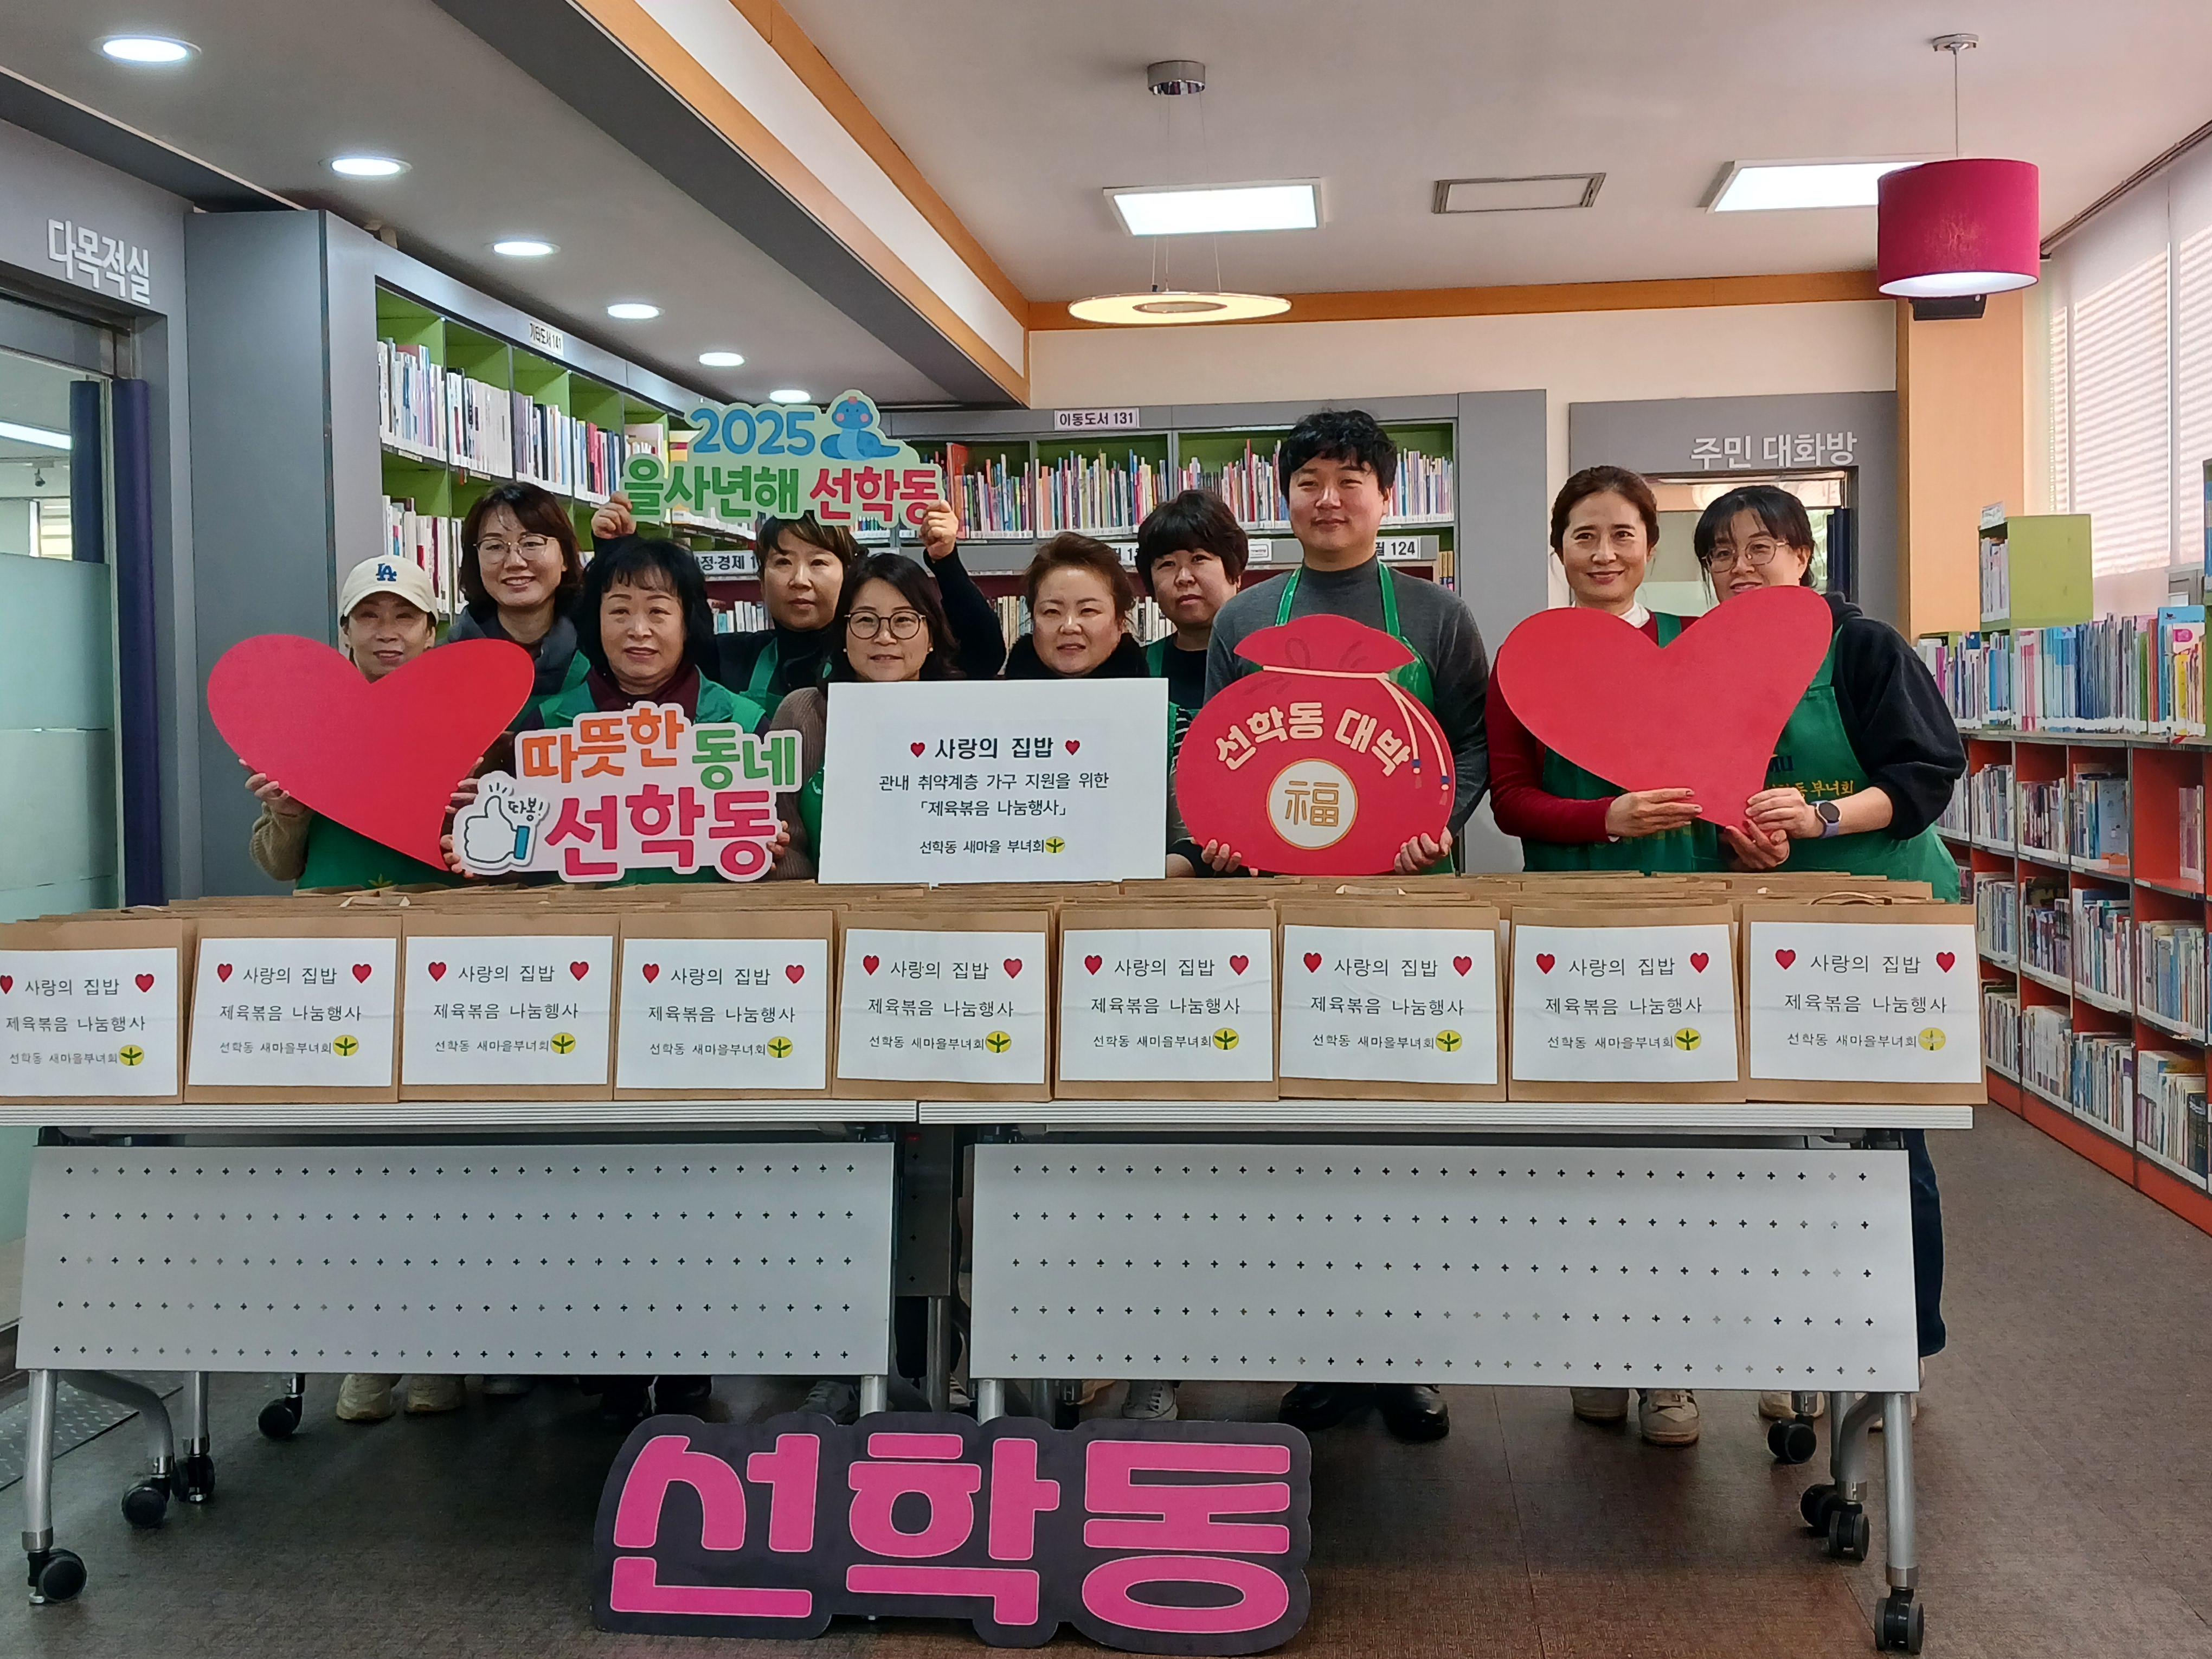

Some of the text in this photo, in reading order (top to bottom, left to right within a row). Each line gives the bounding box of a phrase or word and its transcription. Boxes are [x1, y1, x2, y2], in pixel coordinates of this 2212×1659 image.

[47, 218, 151, 305] 다목적실
[1059, 412, 1133, 427] 이동도서 131
[691, 408, 815, 456] 2025
[1690, 432, 1857, 470] 주민 대화방
[624, 459, 939, 524] 을사년해 선학동
[1391, 541, 1416, 556] 124
[376, 563, 397, 582] LA
[522, 708, 795, 789] 따뜻한 동네
[934, 737, 1054, 760] 사랑의 집밥
[1216, 702, 1411, 776] 선학동 대박
[879, 771, 1110, 791] 관내 취약계층 가구 지원을 위한
[1811, 780, 1854, 798] 부녀회
[507, 797, 543, 821] 따봉!
[921, 799, 1066, 817] 「제육볶음 나눔행사」
[1285, 780, 1339, 827] 福
[544, 783, 776, 876] 선학동
[919, 839, 1044, 854] 선학동 새마을 부녀회
[458, 964, 555, 983] 사랑의 집밥
[890, 960, 989, 980] 사랑의 집밥
[1114, 958, 1216, 978] 사랑의 집밥
[1334, 958, 1438, 978] 사랑의 집밥
[1568, 957, 1675, 978] 사랑의 집밥
[1810, 954, 1921, 974] 사랑의 집밥
[243, 967, 338, 985] 사랑의 집밥
[670, 967, 771, 986] 사랑의 집밥
[24, 978, 120, 997] 사랑의 집밥
[219, 1004, 362, 1022] 제육볶음 나눔행사
[433, 1002, 578, 1020] 제육볶음 나눔행사
[867, 998, 1014, 1018] 제육볶음 나눔행사
[1091, 997, 1240, 1015] 제육볶음 나눔행사
[1310, 995, 1464, 1017] 제육볶음 나눔행사
[1545, 996, 1702, 1016] 제육볶음 나눔행사
[1784, 993, 1947, 1014] 제육볶음 나눔행사
[6, 1015, 146, 1032] 제육볶음 나눔행사
[648, 1006, 796, 1024] 제육볶음 나눔행사
[610, 1432, 1291, 1634] 선학동
